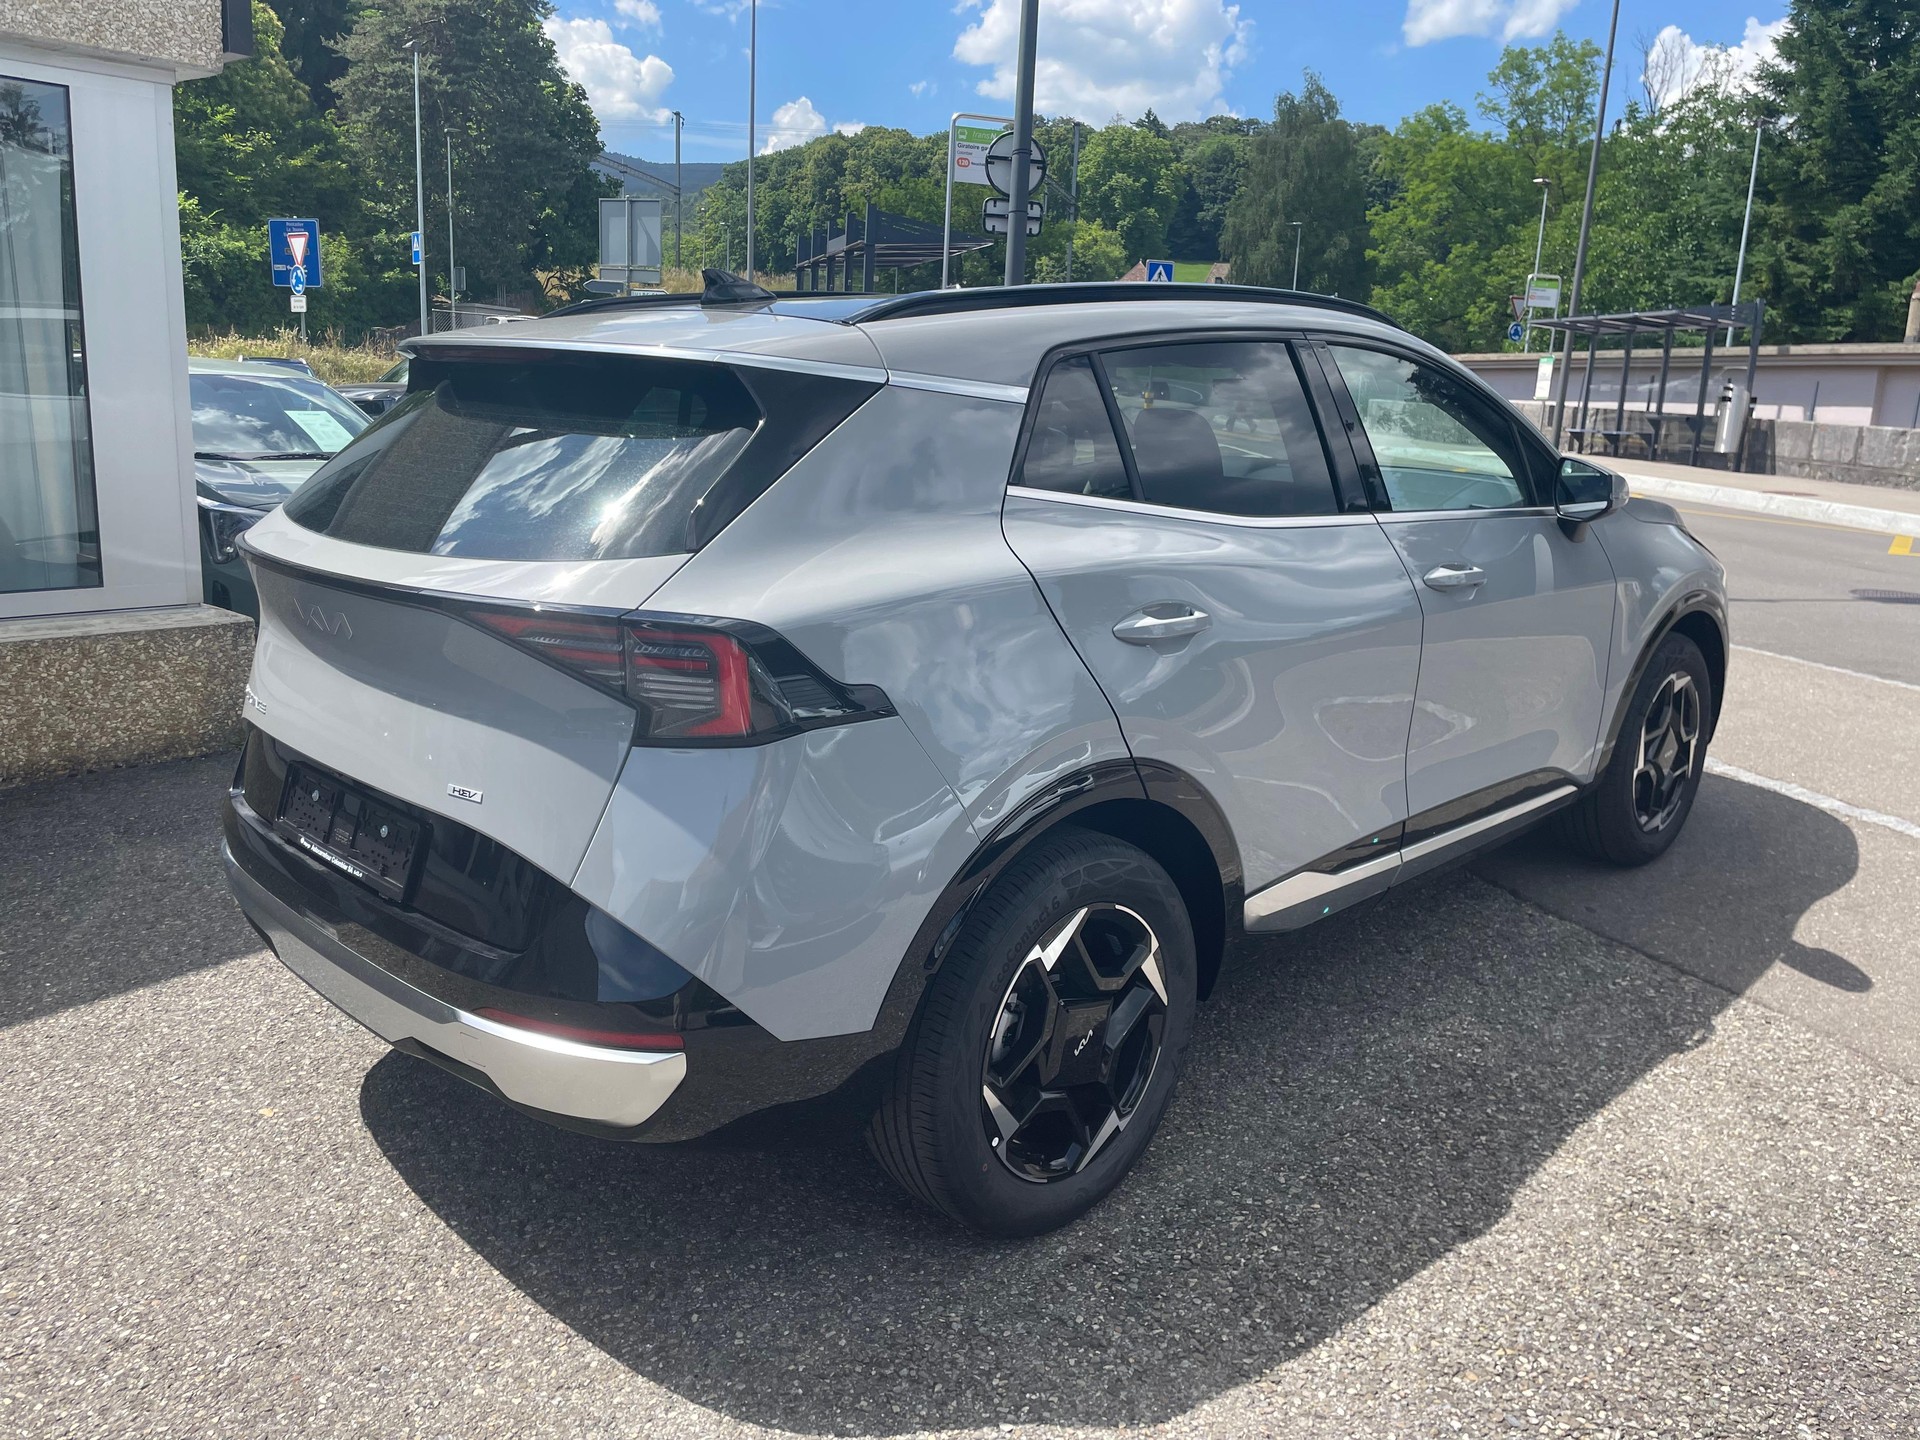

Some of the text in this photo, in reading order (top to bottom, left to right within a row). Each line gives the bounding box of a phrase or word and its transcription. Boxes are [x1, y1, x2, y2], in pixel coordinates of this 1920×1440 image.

[293, 597, 353, 640] KIA
[452, 786, 477, 799] HEV
[1051, 895, 1061, 911] 6
[1073, 1029, 1094, 1057] KIA
